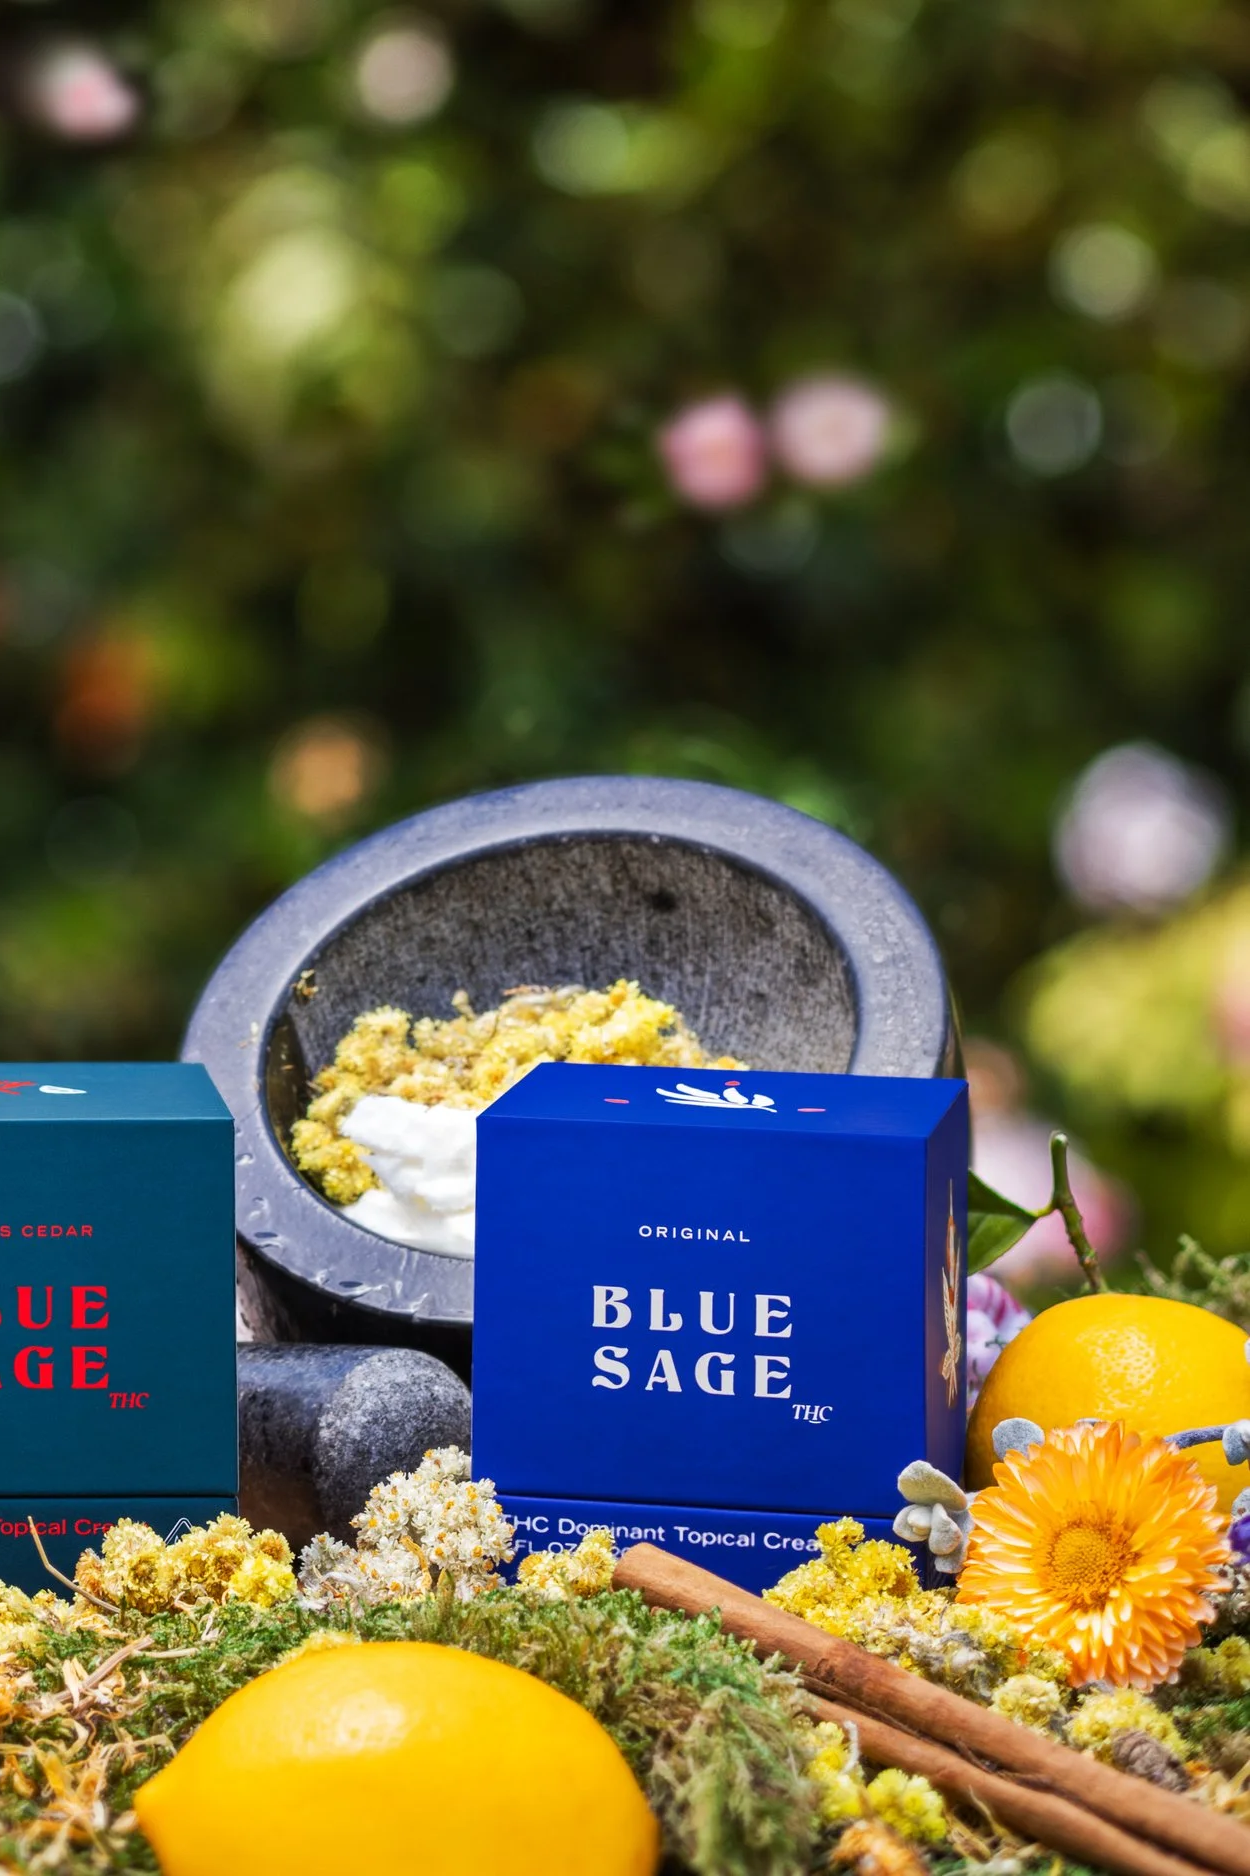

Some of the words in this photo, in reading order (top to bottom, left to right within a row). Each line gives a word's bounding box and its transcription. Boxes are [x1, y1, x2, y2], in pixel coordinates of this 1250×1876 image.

[22, 1225, 93, 1238] CEDAR
[639, 1226, 750, 1243] ORIGINAL
[592, 1285, 792, 1338] BLUE
[591, 1345, 792, 1399] SAGE
[792, 1404, 833, 1424] THC
[109, 1392, 150, 1409] THC
[673, 1526, 756, 1548] Topical
[763, 1532, 821, 1552] Crea
